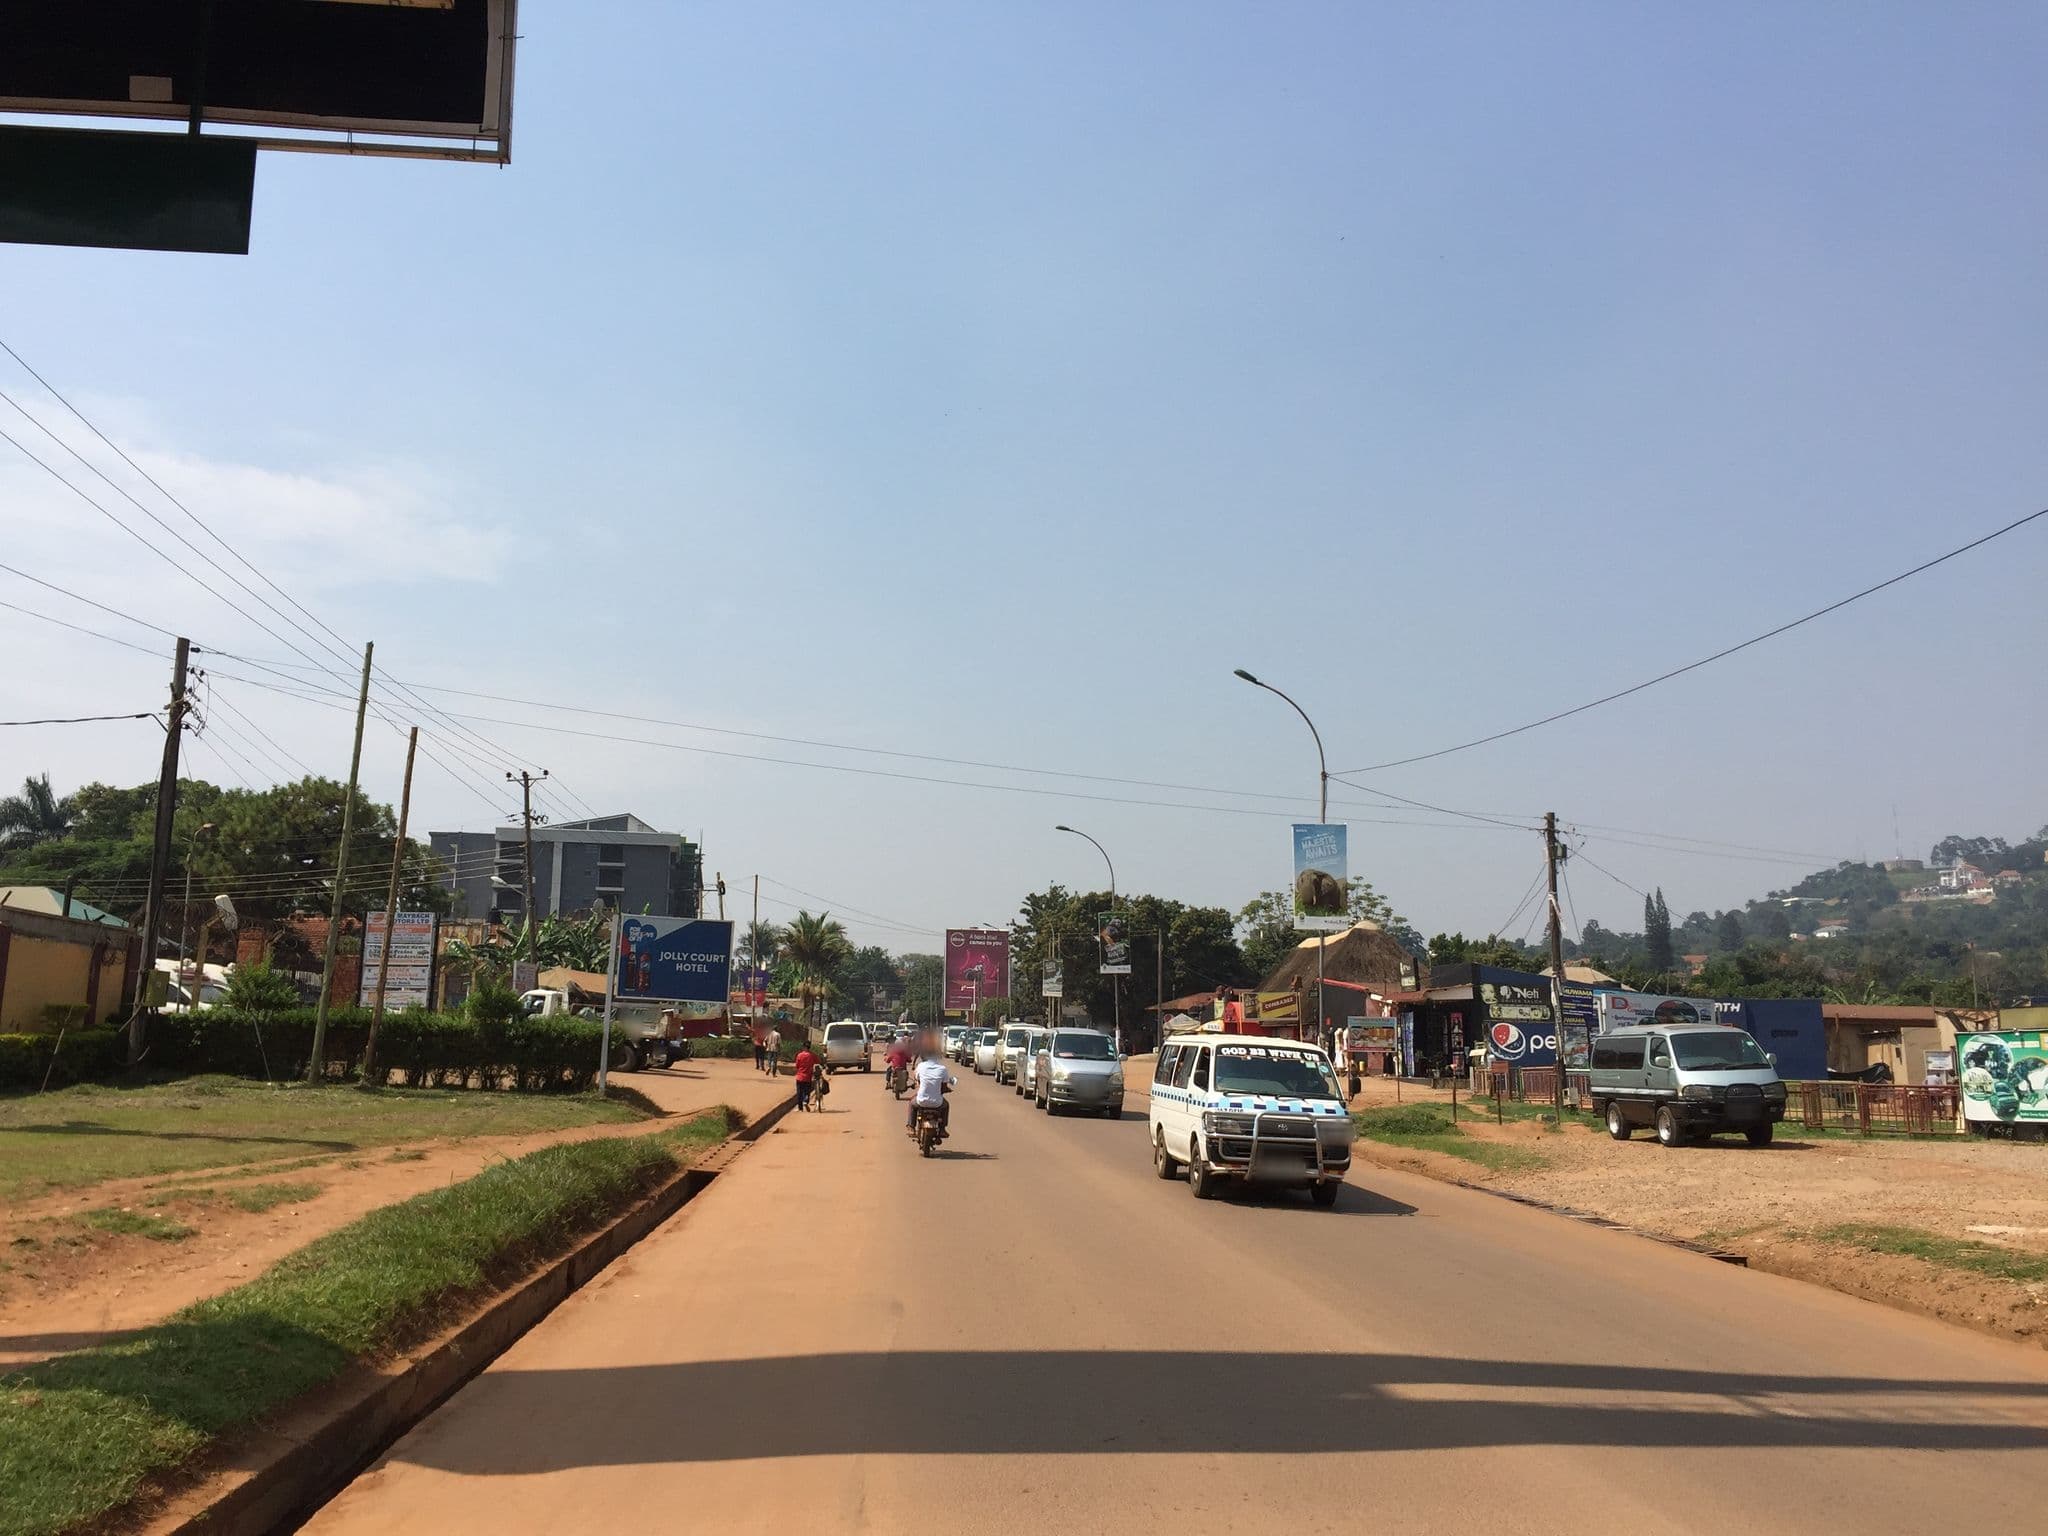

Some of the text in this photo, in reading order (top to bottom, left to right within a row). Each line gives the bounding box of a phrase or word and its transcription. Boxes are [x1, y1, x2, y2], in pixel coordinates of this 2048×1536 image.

[1301, 835, 1336, 850] MAJESTIC
[1305, 845, 1338, 860] AWAITS
[659, 951, 726, 963] JOLLY COURT
[676, 963, 709, 973] HOTEL
[1530, 1034, 1557, 1054] pe
[1221, 1047, 1319, 1061] GOD BE WITH US
